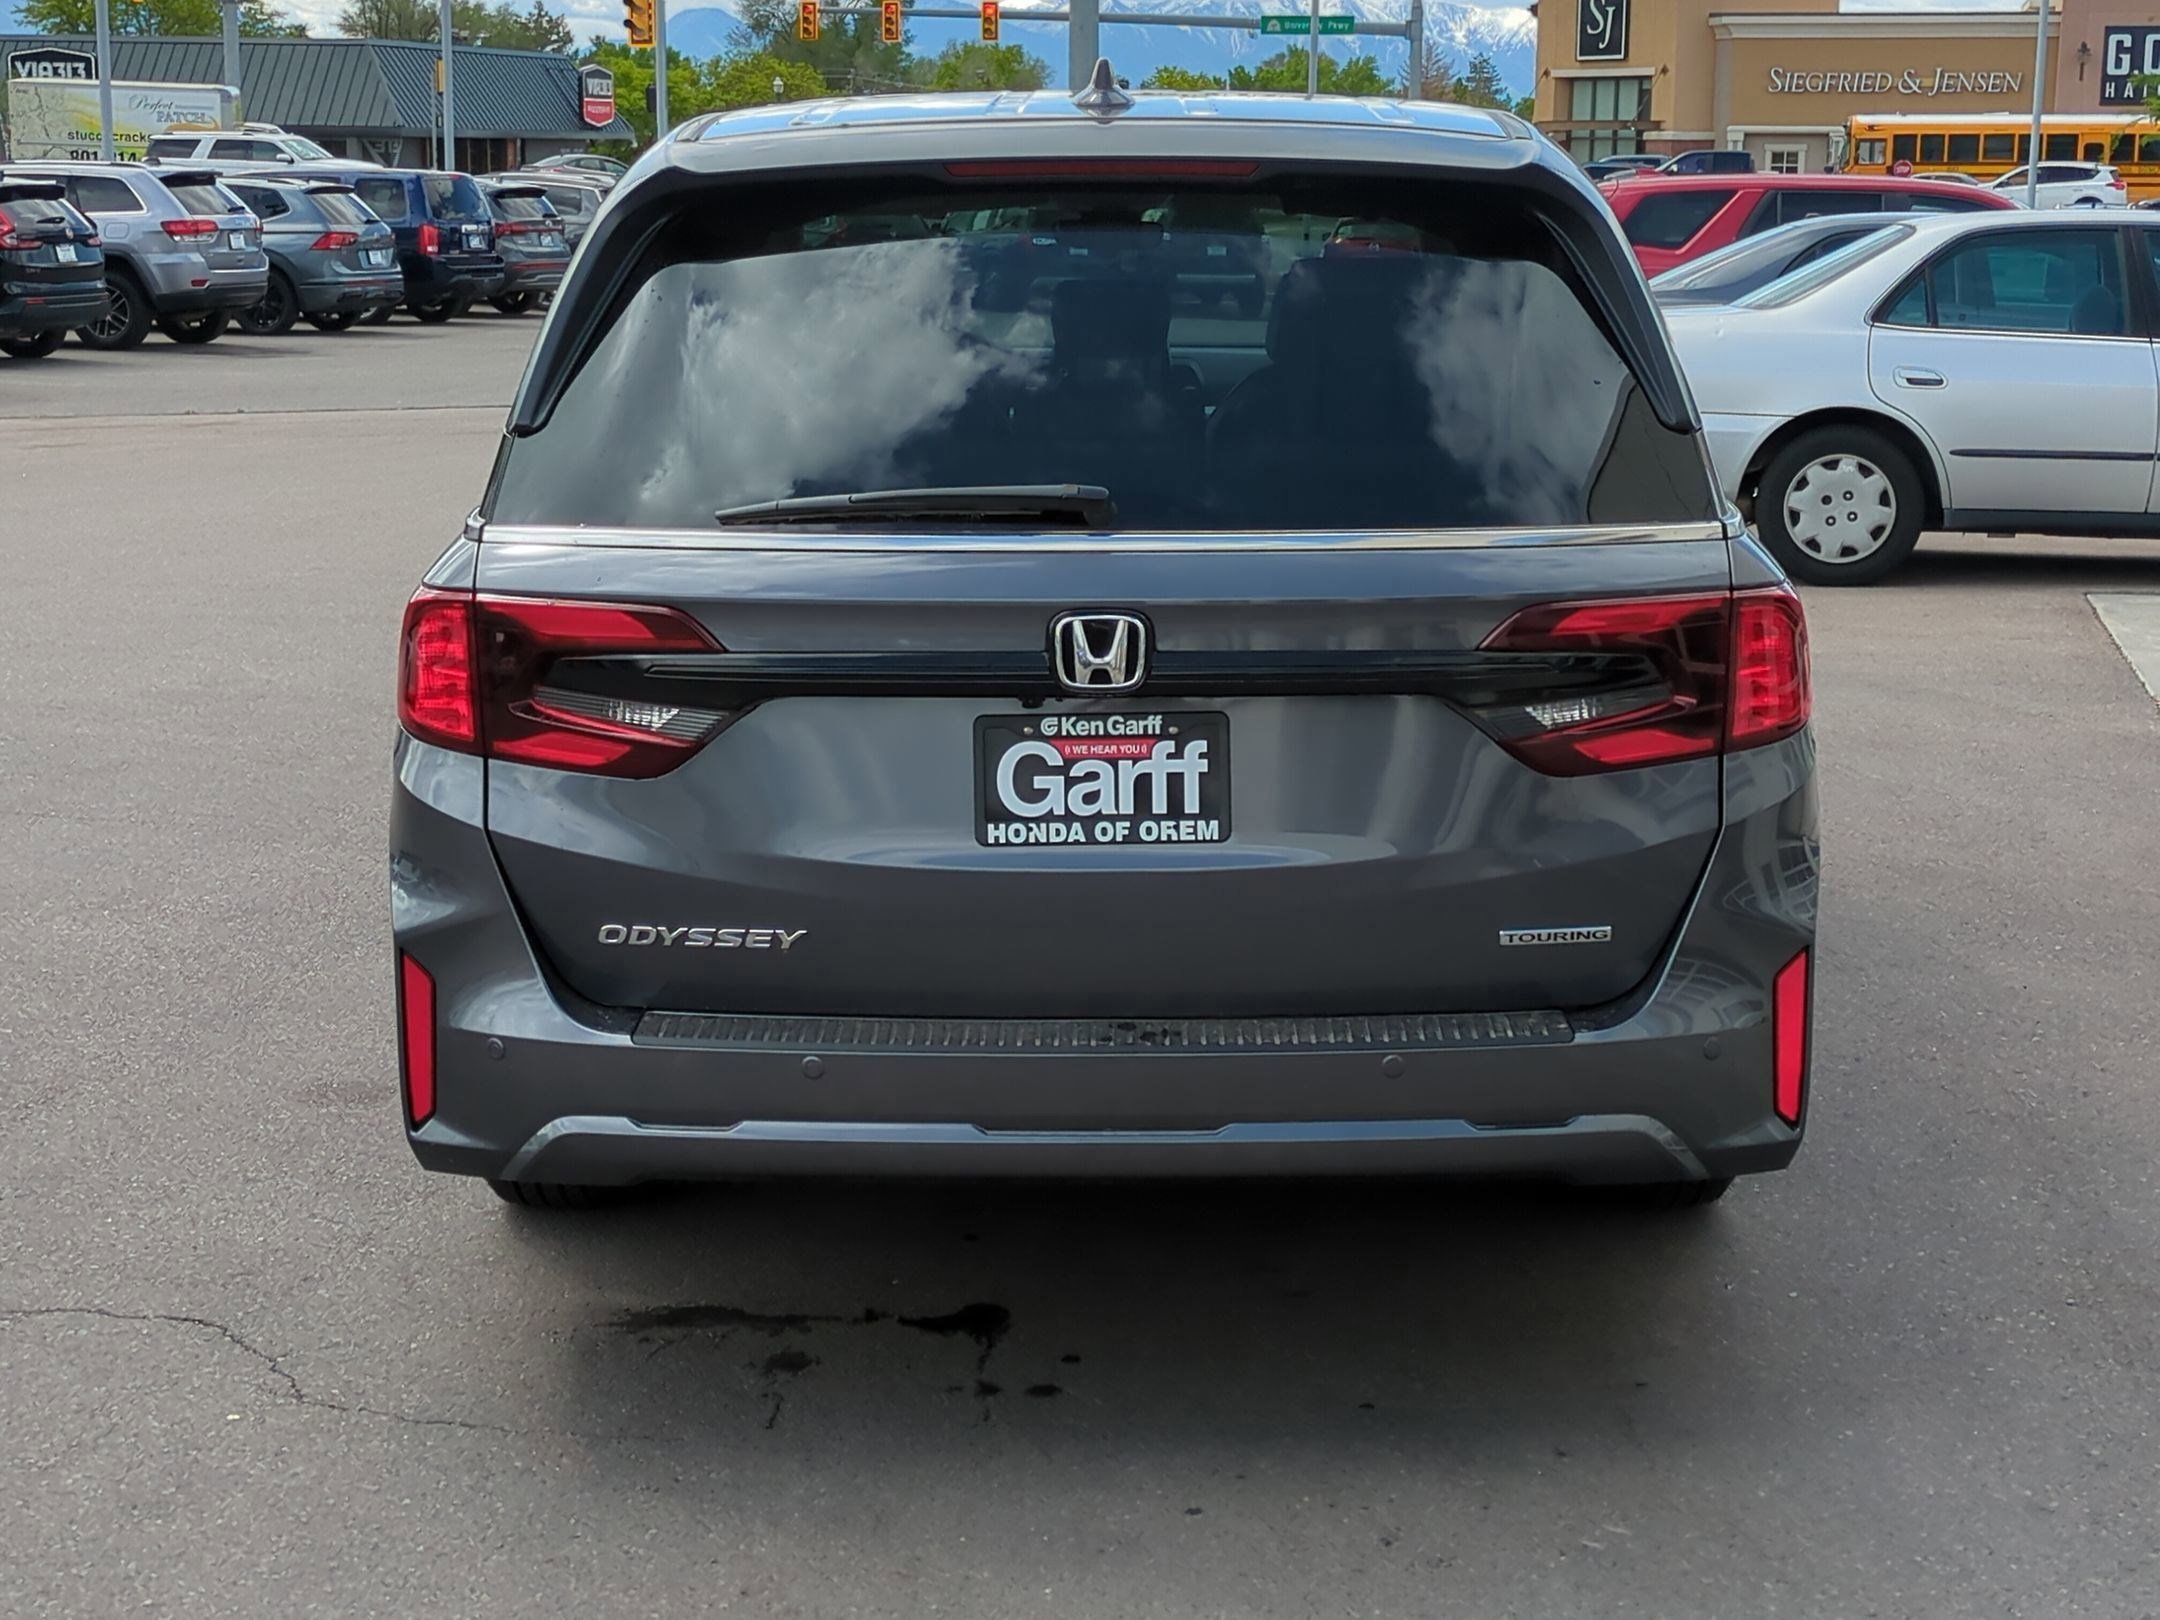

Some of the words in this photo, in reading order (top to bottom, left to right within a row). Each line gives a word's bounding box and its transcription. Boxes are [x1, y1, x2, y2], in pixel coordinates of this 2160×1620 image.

[1586, 0, 1617, 49] SJ
[1767, 67, 1893, 94] SIEGFRIED
[1897, 69, 1923, 95] &
[1928, 66, 2023, 97] JENSEN
[2105, 81, 2160, 99] HAI
[156, 110, 206, 124] PATCH
[1060, 716, 1105, 736] Ken
[1106, 714, 1163, 736] Garff
[1072, 744, 1089, 755] WE
[1090, 744, 1118, 754] HEAR
[1119, 744, 1140, 754] YOU
[996, 739, 1209, 818] Garff
[986, 822, 1087, 844] HONDA
[1094, 821, 1131, 843] OF
[1138, 819, 1220, 842] OREM
[597, 923, 808, 950] ODYSSEY
[1503, 929, 1609, 944] TOURING
